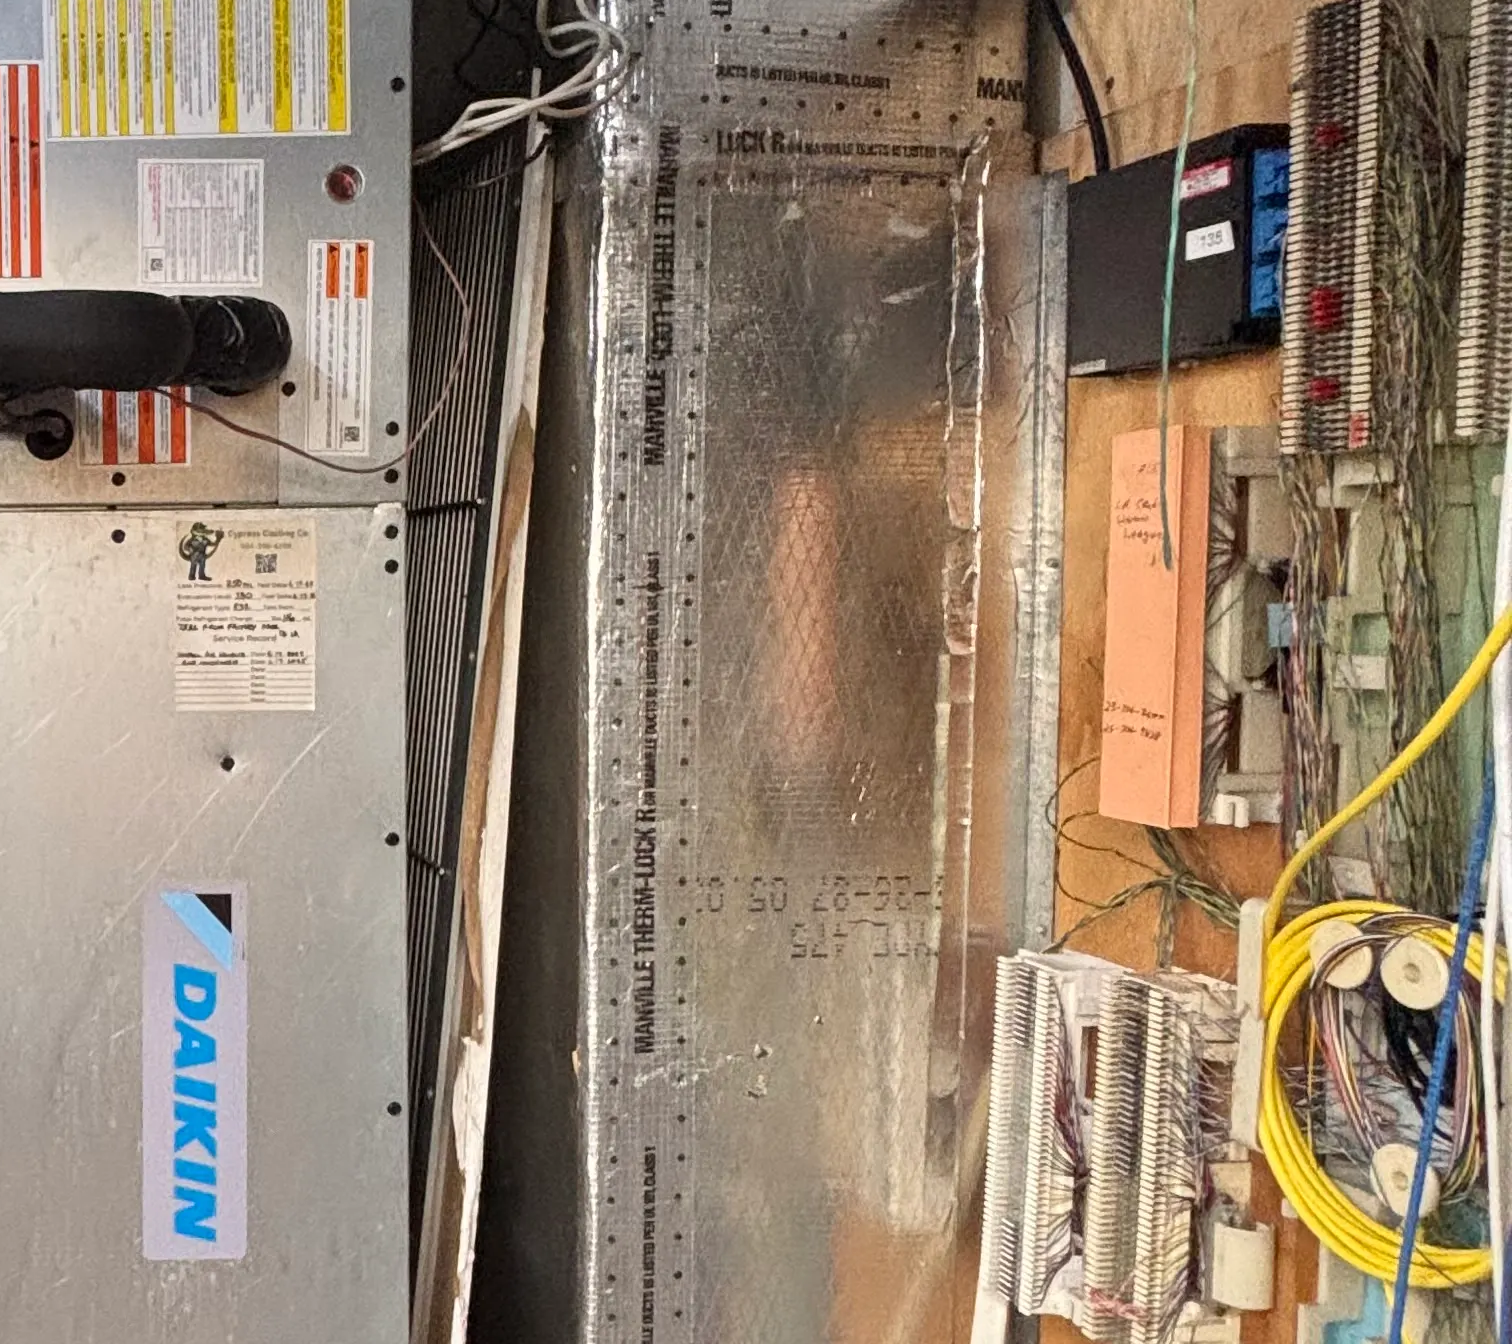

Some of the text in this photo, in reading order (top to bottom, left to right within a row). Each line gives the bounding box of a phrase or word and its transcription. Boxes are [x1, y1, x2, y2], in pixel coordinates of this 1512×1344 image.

[643, 369, 665, 466] MANVILLE
[227, 529, 260, 541] Cypress
[262, 529, 295, 539] Cooling
[213, 635, 244, 643] Service
[645, 649, 658, 685] LISTED
[633, 828, 656, 956] THERM-LOCK
[633, 960, 654, 1054] MANVILLE
[173, 963, 217, 1242] DAIKIN
